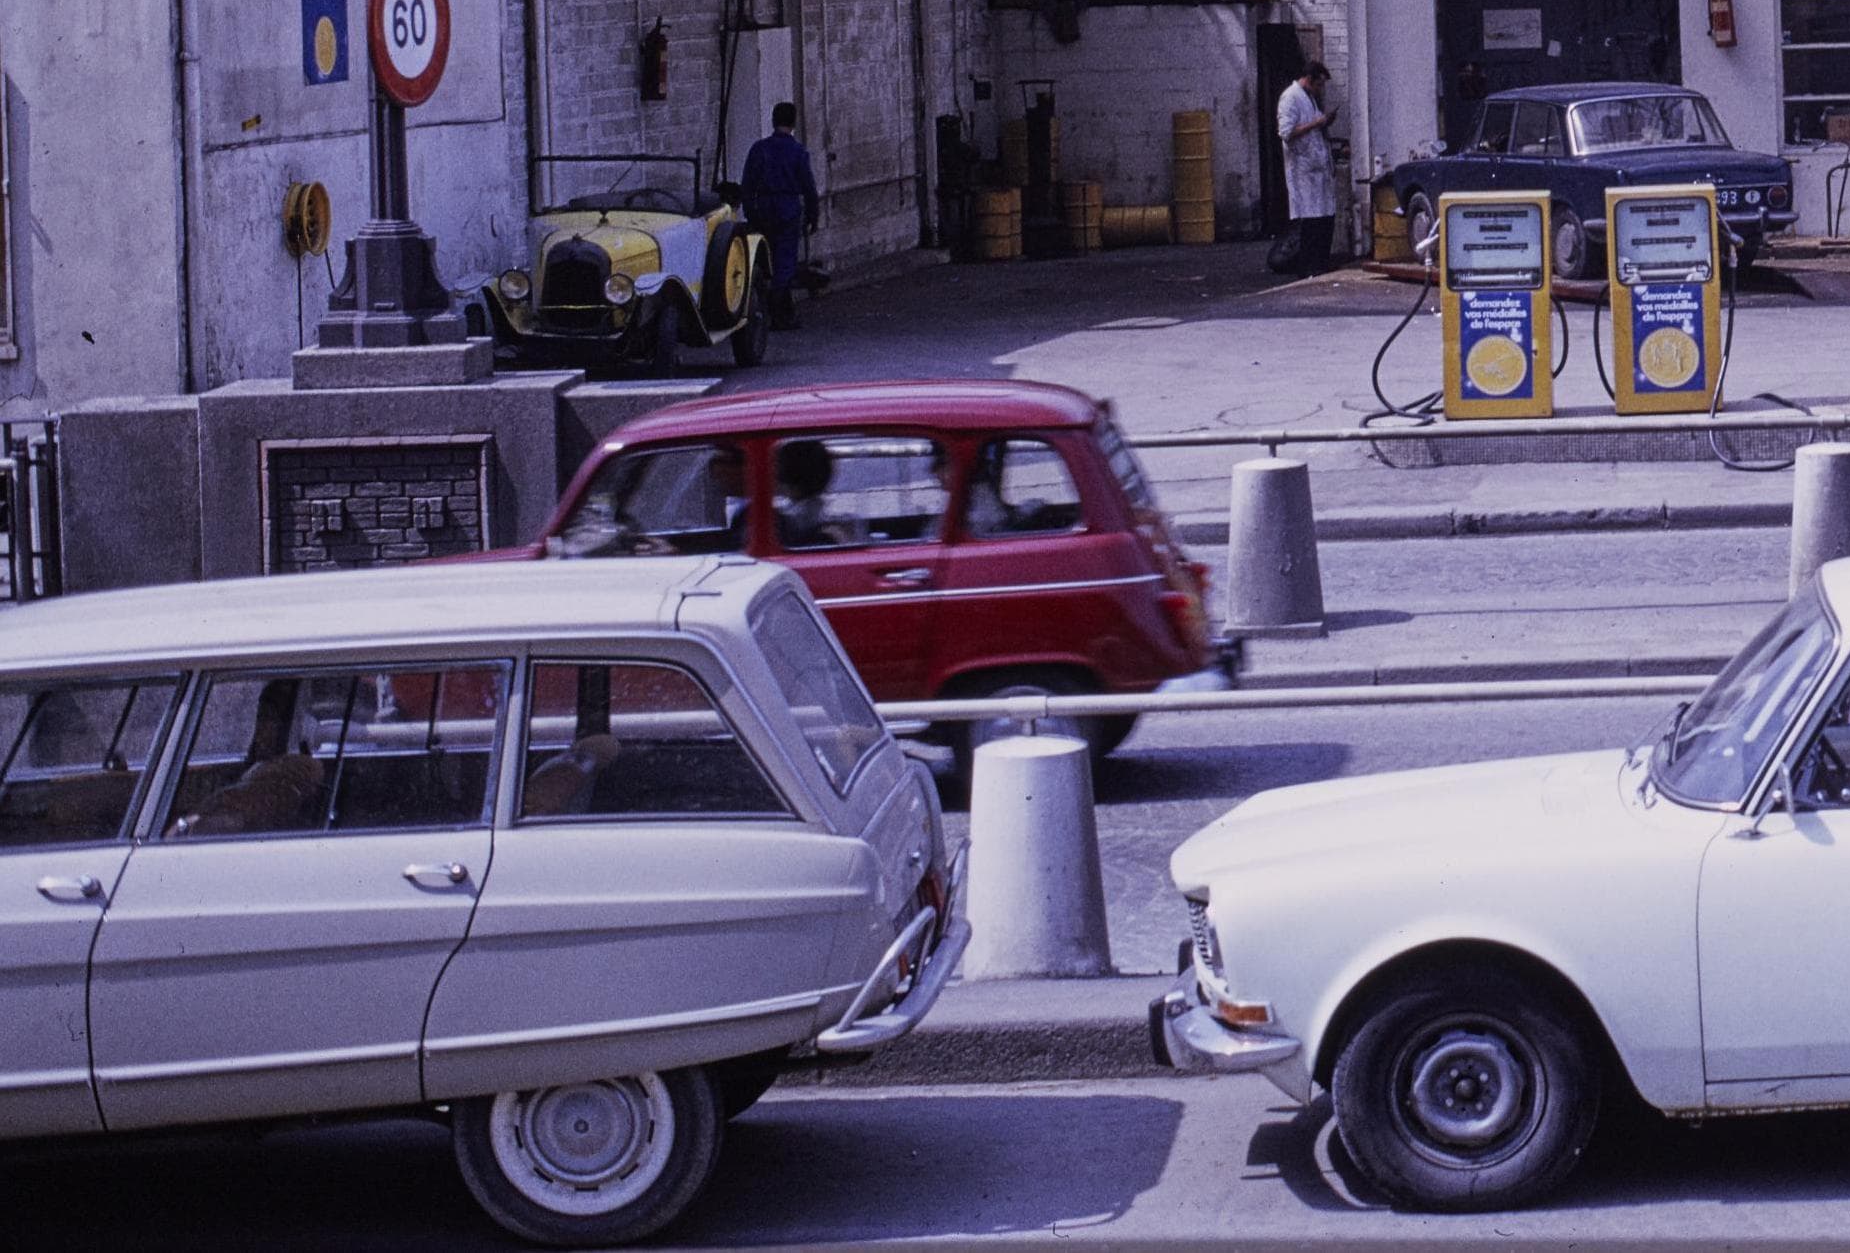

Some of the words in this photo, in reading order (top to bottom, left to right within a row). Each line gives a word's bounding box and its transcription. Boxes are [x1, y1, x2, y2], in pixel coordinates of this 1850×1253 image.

[1642, 290, 1692, 301] demandez
[1470, 298, 1521, 309] demandez
[1655, 300, 1698, 310] médailles
[1483, 308, 1527, 318] médailles
[1642, 312, 1655, 321] de
[1470, 319, 1483, 328] de
